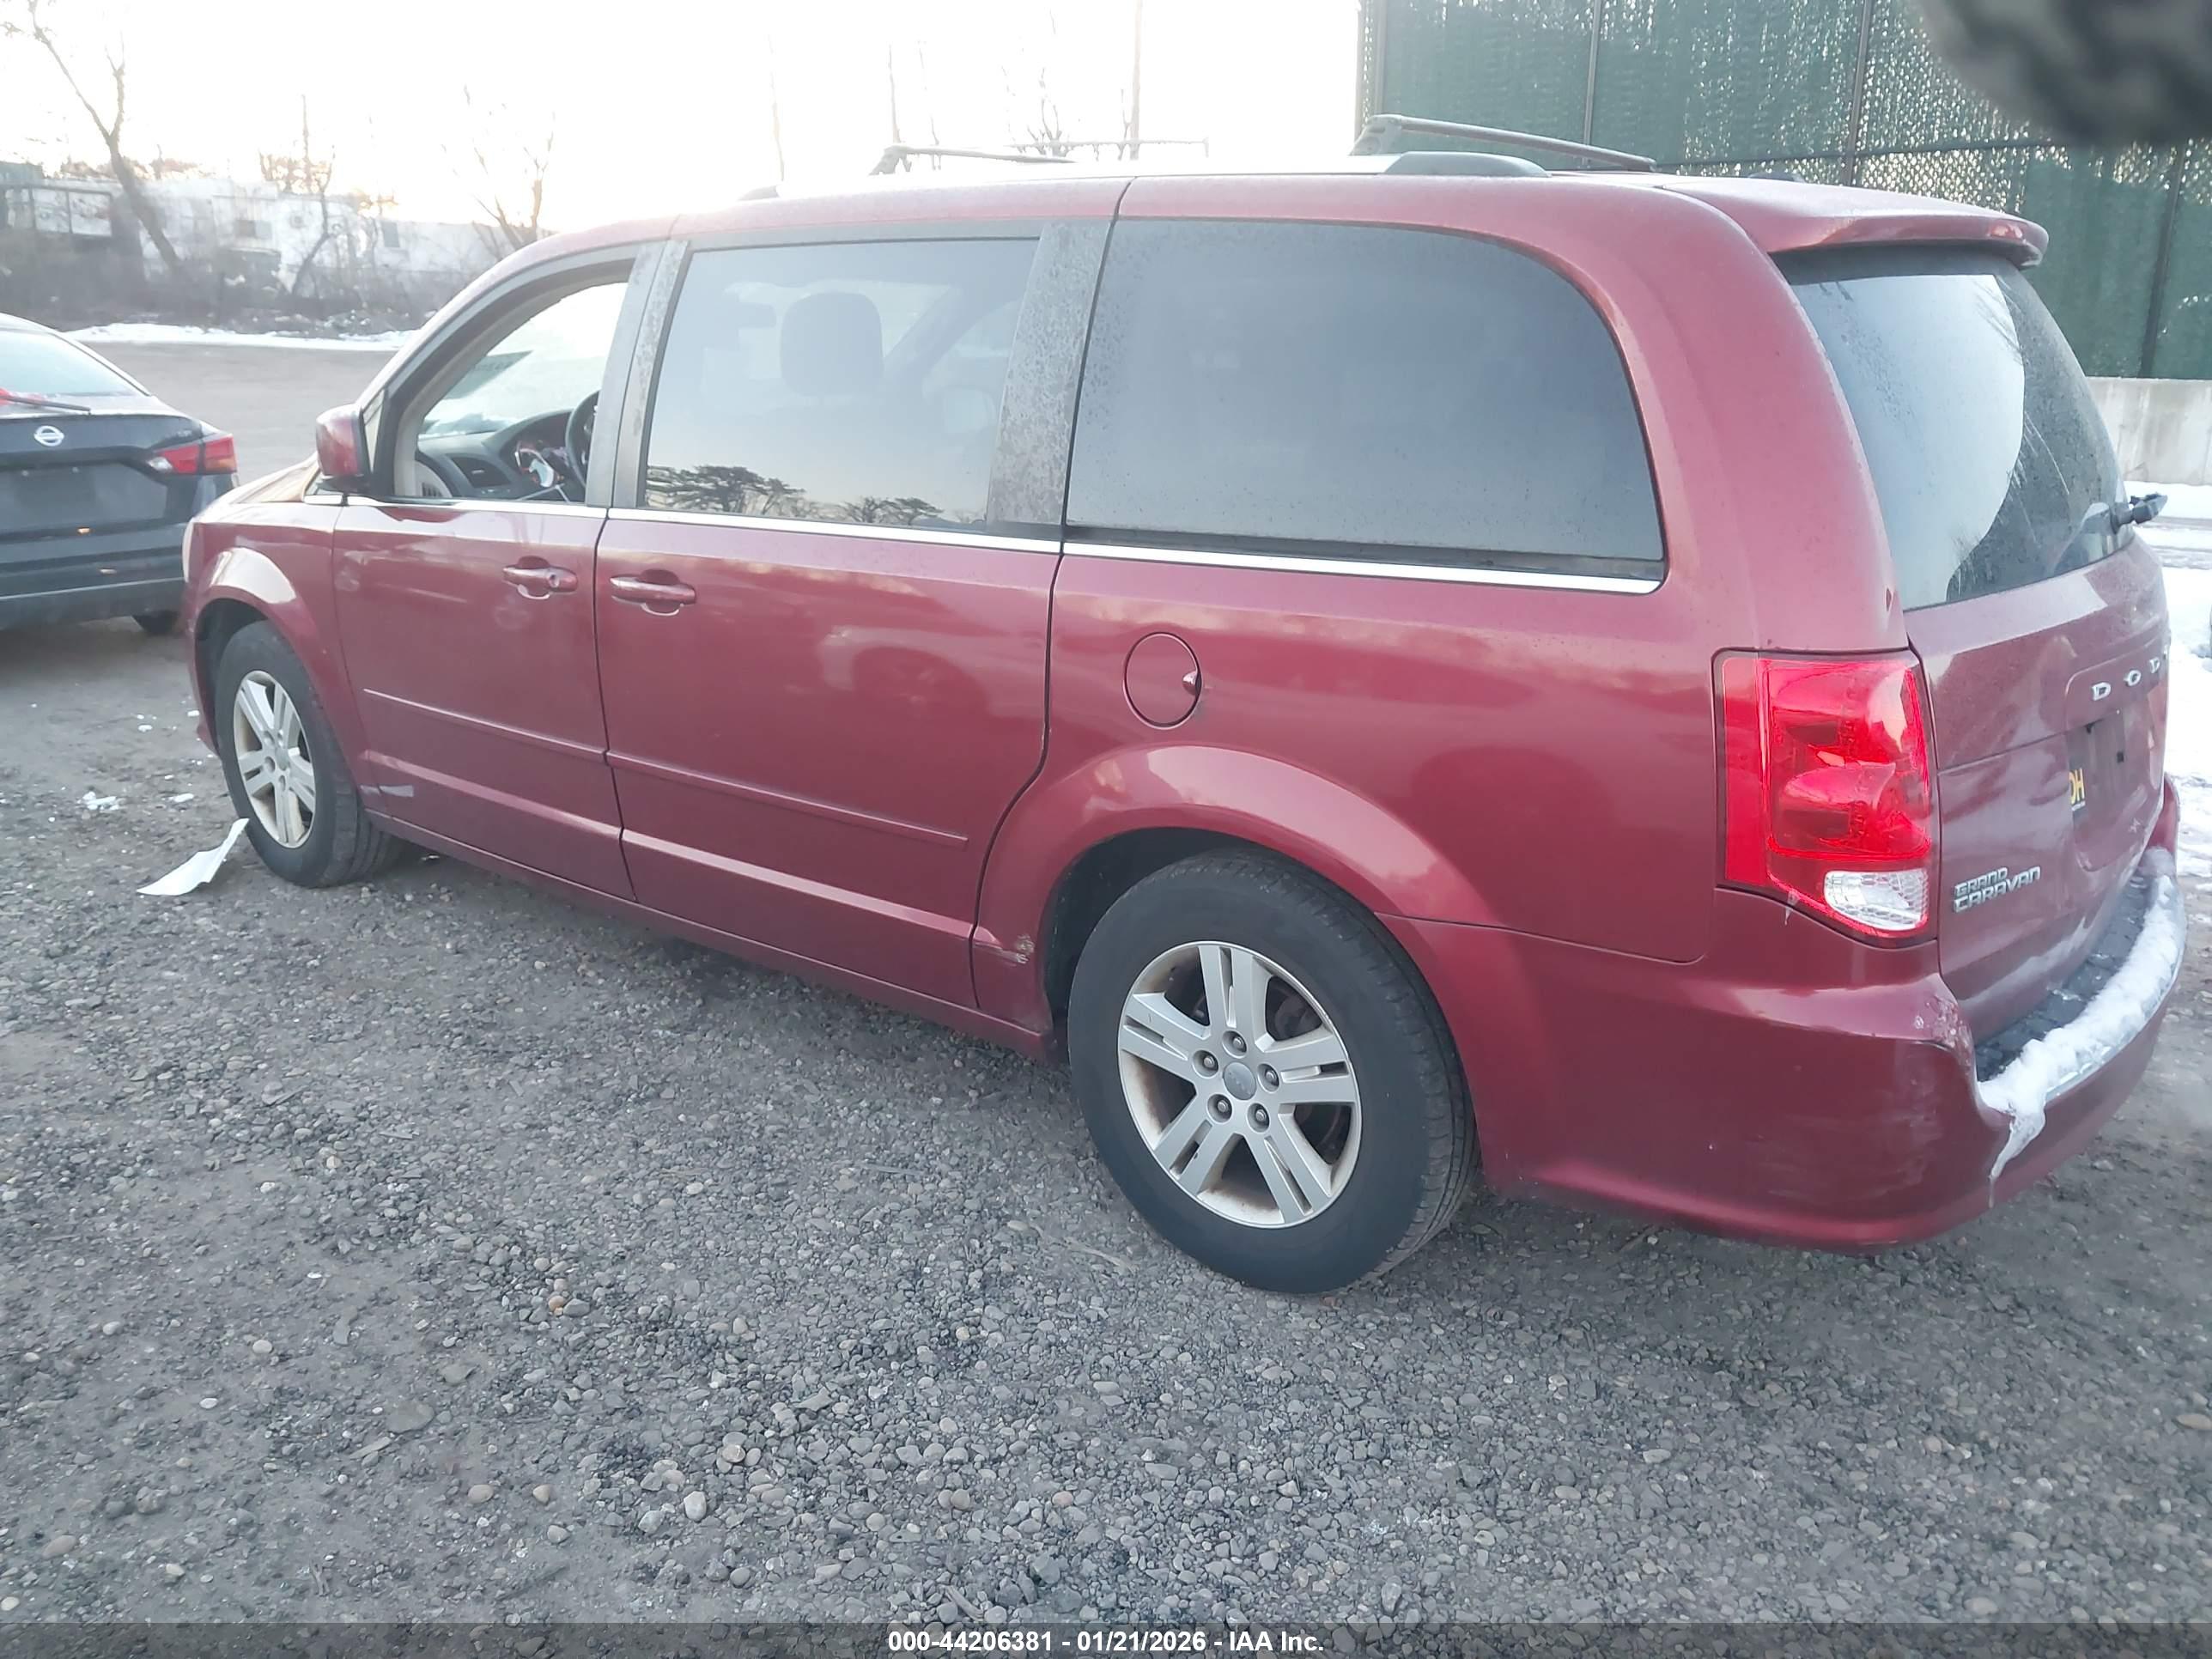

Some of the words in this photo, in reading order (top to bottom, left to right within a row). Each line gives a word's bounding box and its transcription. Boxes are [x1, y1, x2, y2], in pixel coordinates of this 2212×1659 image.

[2092, 643, 2168, 701] DOD
[1954, 866, 2008, 896] GRAND
[1954, 866, 2041, 913] CARAVAN
